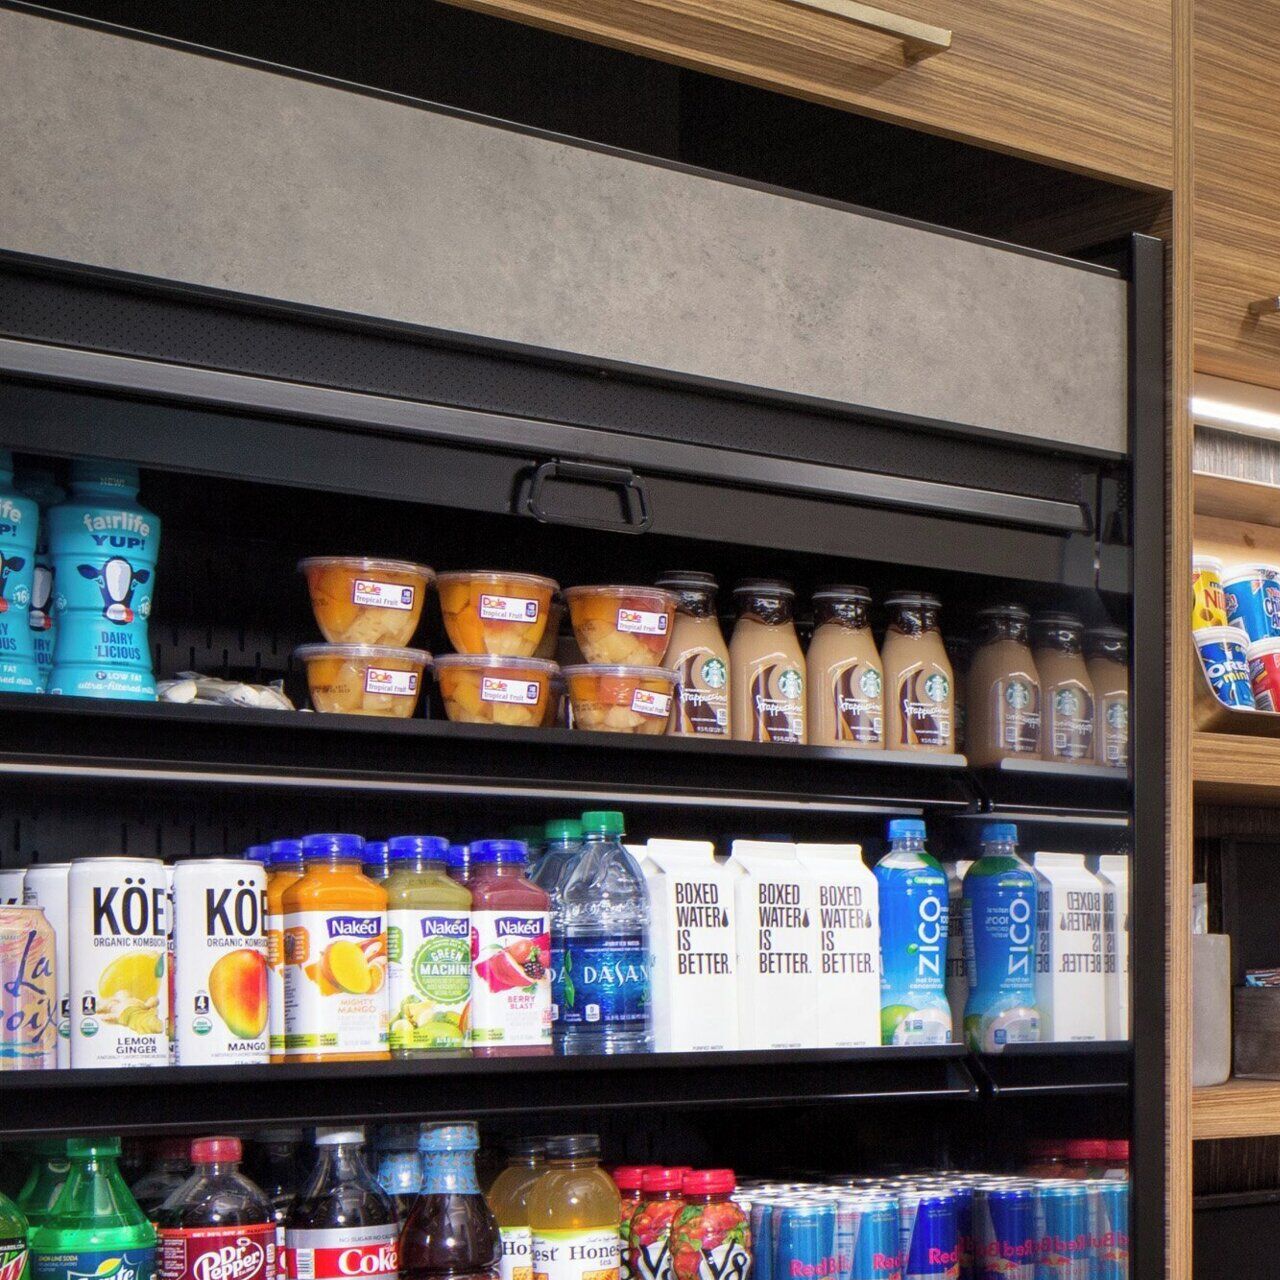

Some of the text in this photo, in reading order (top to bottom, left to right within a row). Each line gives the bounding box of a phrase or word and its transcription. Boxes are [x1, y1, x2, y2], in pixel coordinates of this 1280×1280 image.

[91, 535, 146, 550] YUP!
[619, 610, 642, 622] Dole
[101, 631, 133, 645] DAIRY
[635, 690, 655, 702] Dole
[675, 882, 719, 904] BOXED
[758, 882, 801, 904] BOXED
[820, 885, 862, 906] BOXED
[676, 907, 722, 928] WATER
[758, 906, 802, 928] WATER
[820, 908, 866, 929] WATER
[207, 938, 243, 947] ORGANIC
[759, 930, 772, 952] IS
[820, 931, 835, 952] IS
[919, 896, 942, 976] ZICO
[431, 949, 464, 961] GREEN
[678, 952, 733, 974] BETTER.
[759, 952, 812, 974] BETTER.
[822, 953, 875, 974] BETTER.
[507, 995, 536, 1003] BERRY
[509, 1002, 534, 1010] BLAST
[338, 1005, 376, 1014] MANGO
[116, 1046, 157, 1054] GINGER
[118, 1037, 156, 1045] LEMON
[228, 1042, 265, 1051] MANGO
[218, 1246, 245, 1263] Dr
[338, 1246, 397, 1275] Coke
[789, 1259, 828, 1277] Red
